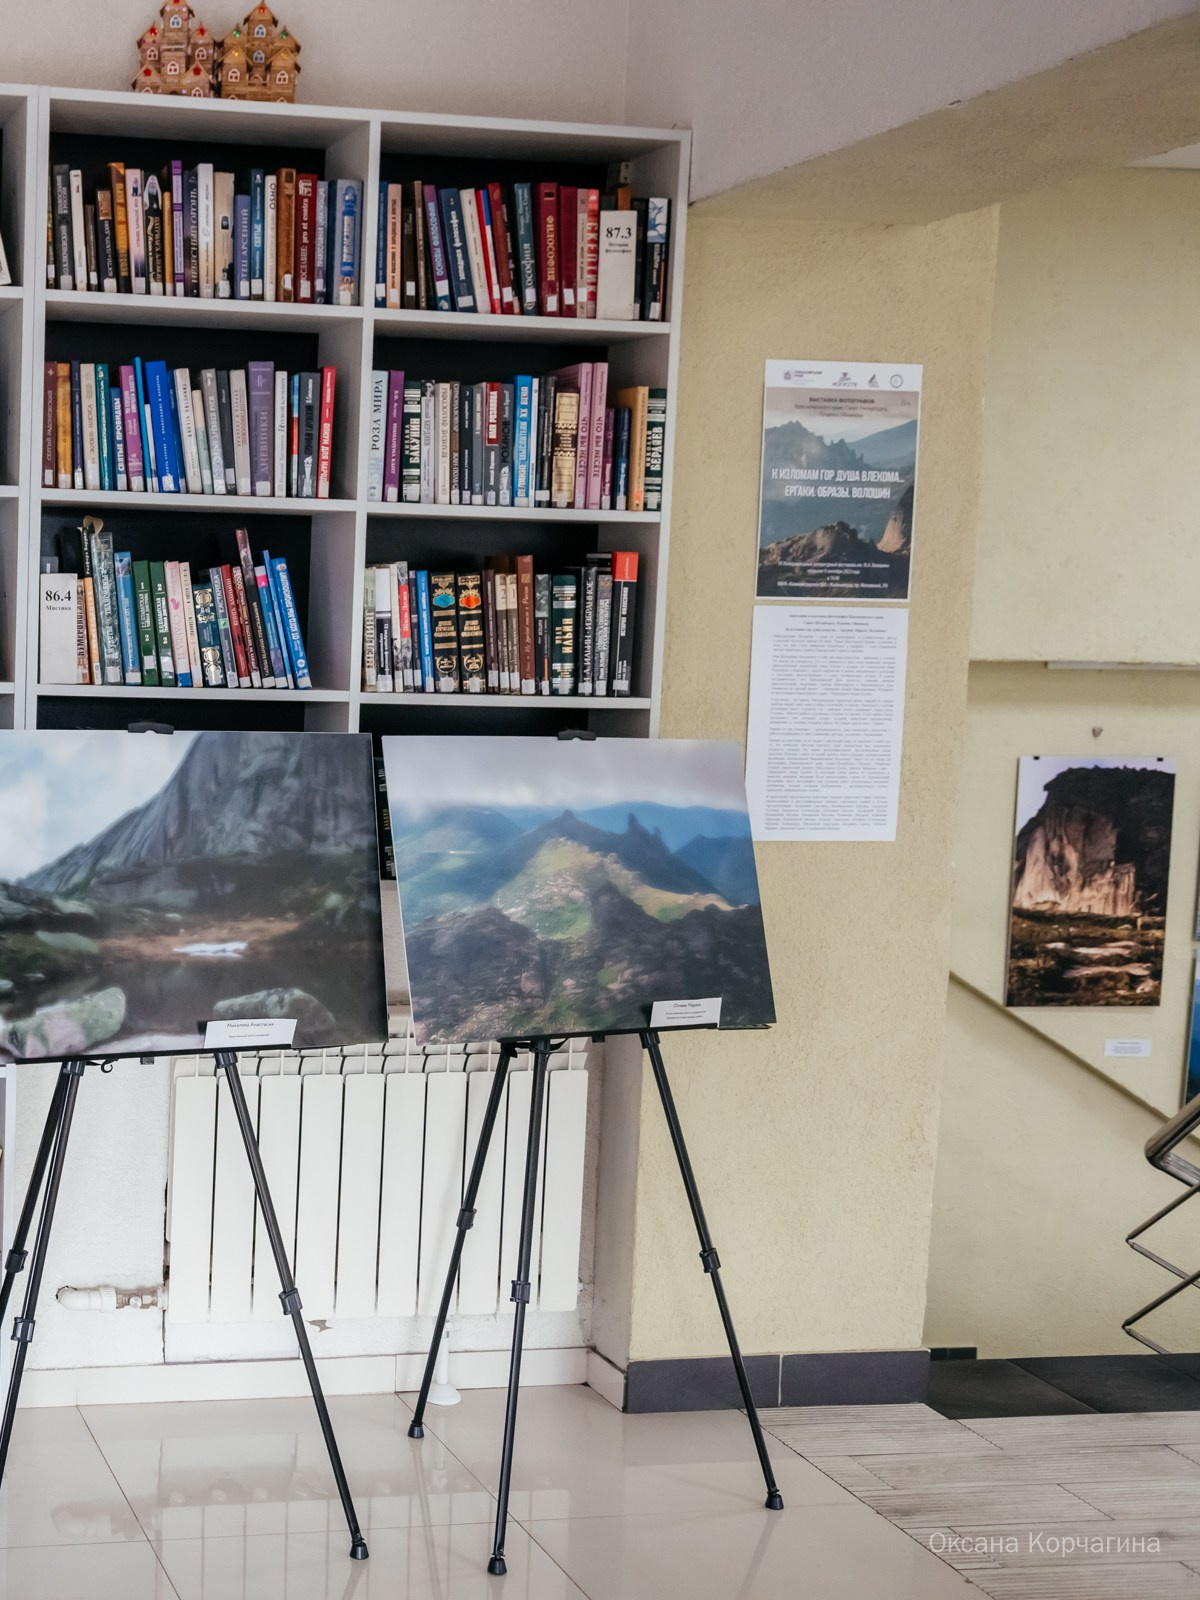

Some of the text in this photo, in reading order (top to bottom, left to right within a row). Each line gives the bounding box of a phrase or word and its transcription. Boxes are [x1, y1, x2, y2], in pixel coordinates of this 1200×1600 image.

[190, 187, 198, 283] НЕБЕСНЫЙ ОГОНЬ
[239, 208, 248, 256] АРСЕНИЙ
[427, 202, 444, 276] ОСНОВЫ ФИЛОСОФИИ
[546, 216, 555, 280] ФИЛОСОФИЯ
[605, 227, 632, 239] 87.3
[371, 379, 383, 450] РОЗА МИРА
[441, 388, 449, 427] ФИЛОСОФЫ
[113, 398, 125, 471] СВЯТЫЕ ПРОВИДЦЫ
[259, 411, 269, 474] ДНЕВНИКИ
[409, 418, 420, 463] БАКУНИН
[501, 421, 510, 463] РОЗАНОВ
[517, 386, 528, 497] ВЕЛИКИЕ МЫСЛИТЕЛИ ВЕКА
[580, 436, 586, 448] ВЫ
[594, 436, 601, 448] ВЫ
[650, 427, 662, 471] БЕРДЯЕВ
[578, 450, 586, 478] НЕСЕТЕ
[592, 450, 600, 478] НЕСЕТЕ
[772, 468, 778, 479] К
[779, 468, 820, 480] ИЗЛОМАМ
[820, 469, 835, 481] ГОР
[835, 470, 860, 482] ДУША
[851, 487, 891, 499] ВОЛОШИН
[45, 589, 72, 602] 86.4
[214, 574, 224, 613] КАСТАНЕДА
[289, 617, 298, 631] КОГО
[292, 631, 300, 640] ОТ
[562, 618, 573, 654] ИЛЬИН
[584, 581, 593, 665] ИЛЬИН ИЗБРАННОЕ
